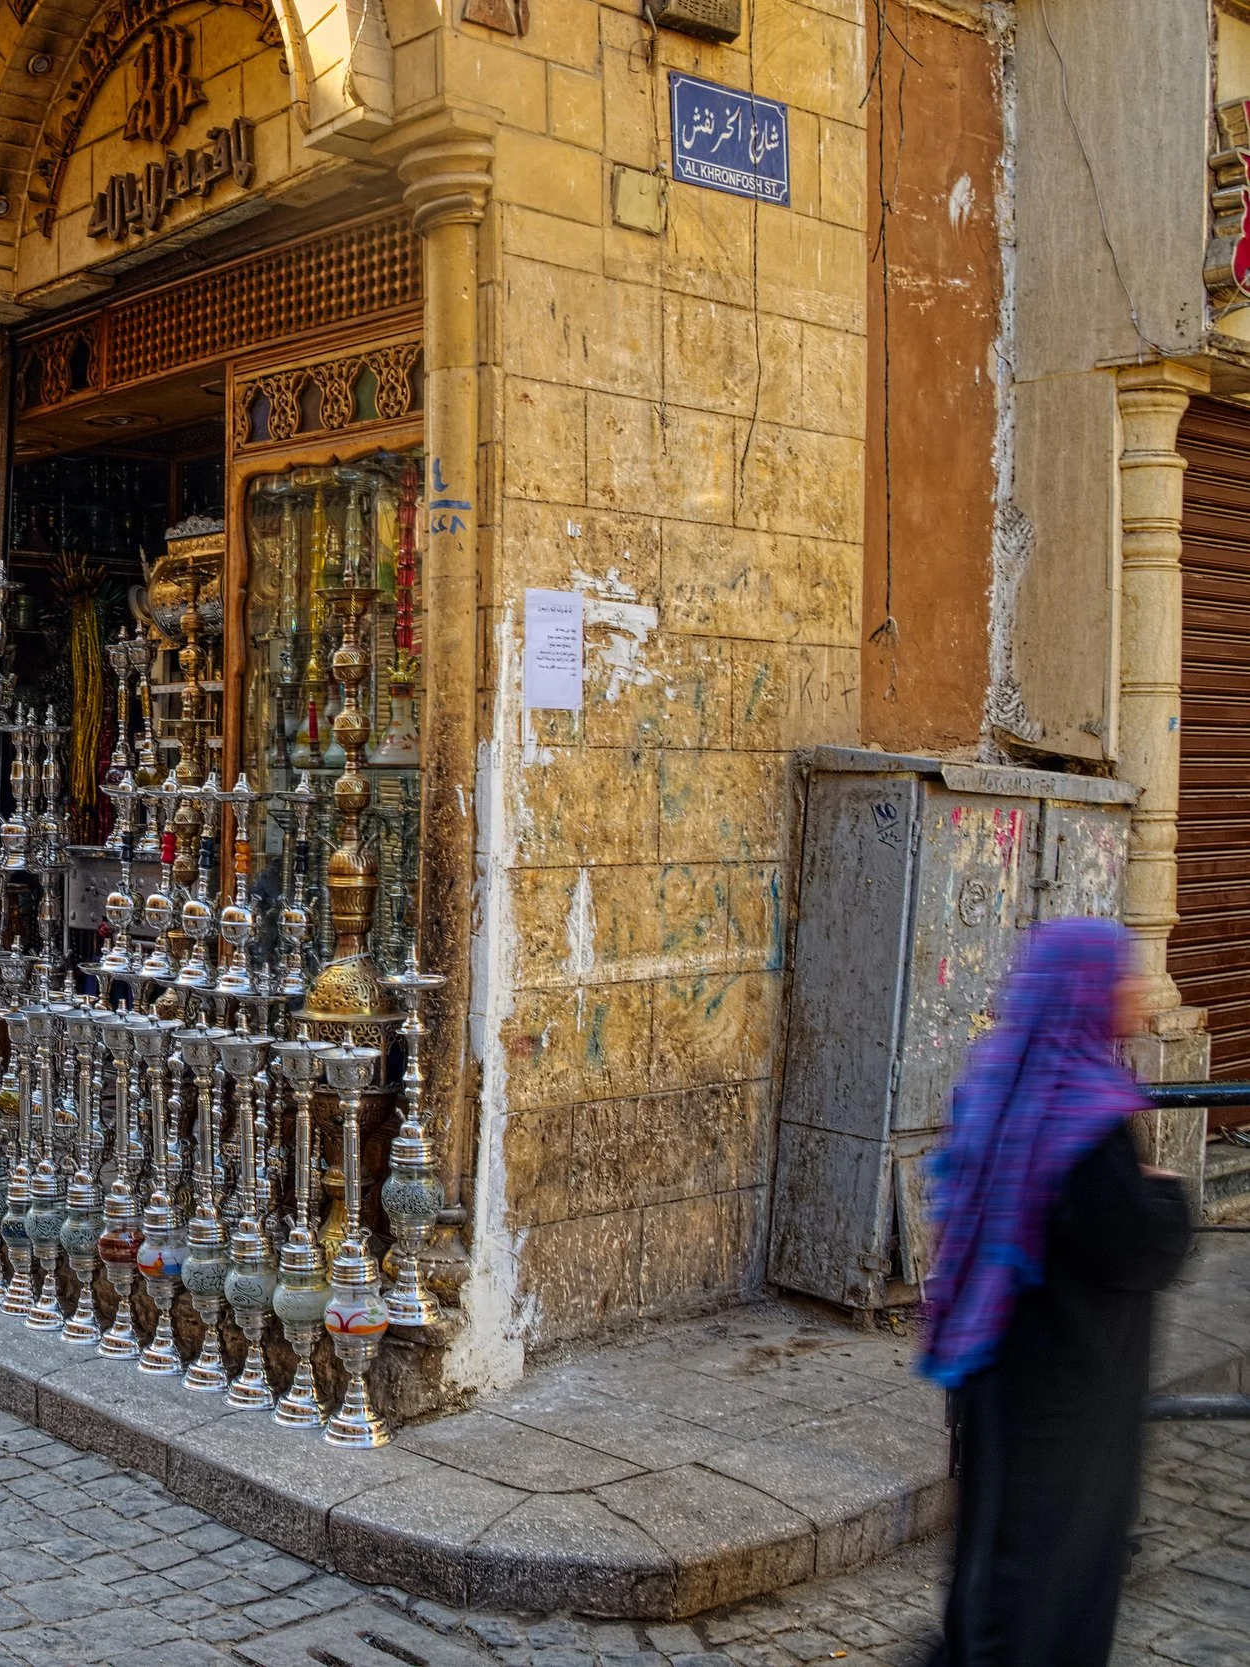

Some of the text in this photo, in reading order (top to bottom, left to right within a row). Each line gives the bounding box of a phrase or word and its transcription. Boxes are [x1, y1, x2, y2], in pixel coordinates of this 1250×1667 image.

[682, 106, 780, 165] شارع الخرنفش
[684, 161, 779, 197] AL KHRONFOSH ST.
